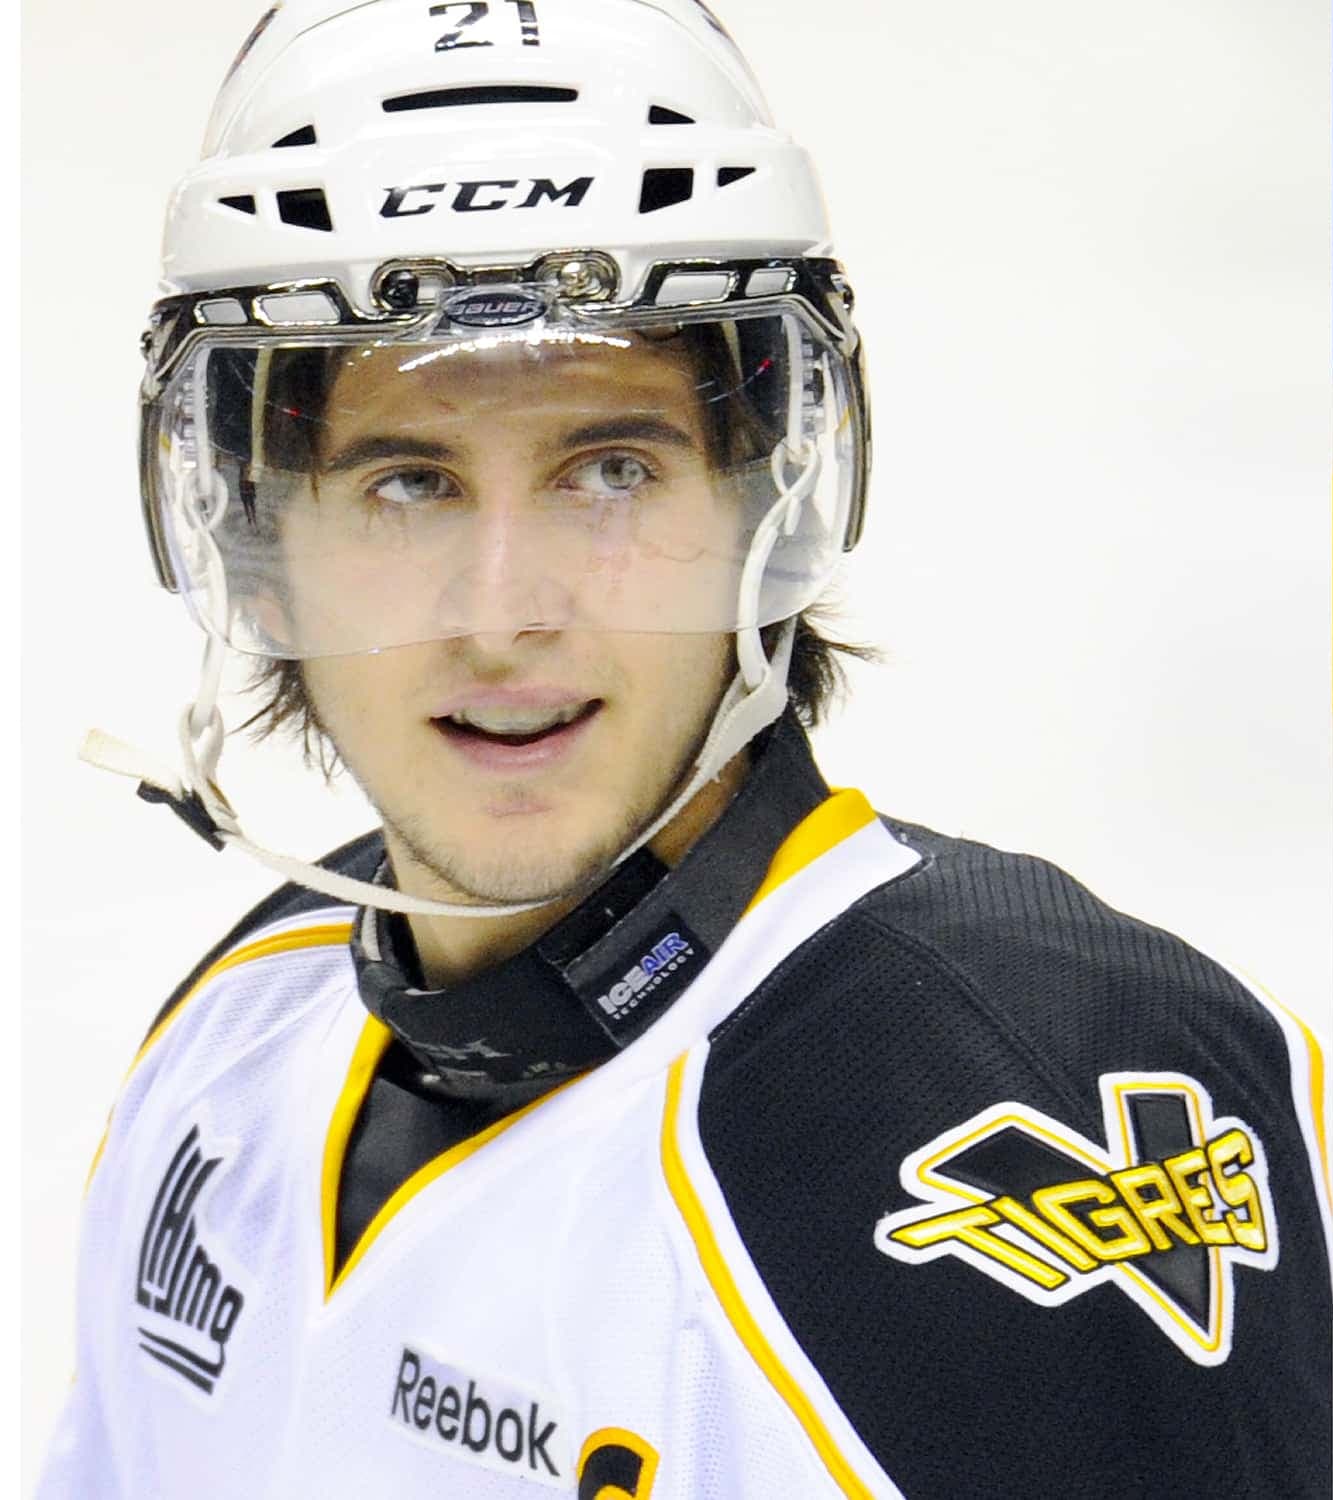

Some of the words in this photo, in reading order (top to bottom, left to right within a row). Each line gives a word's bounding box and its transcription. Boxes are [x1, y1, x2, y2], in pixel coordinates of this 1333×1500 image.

[429, 0, 540, 52] 21
[379, 175, 593, 219] CCM
[888, 1127, 1268, 1290] TIGRES
[391, 1346, 560, 1477] Reebok
